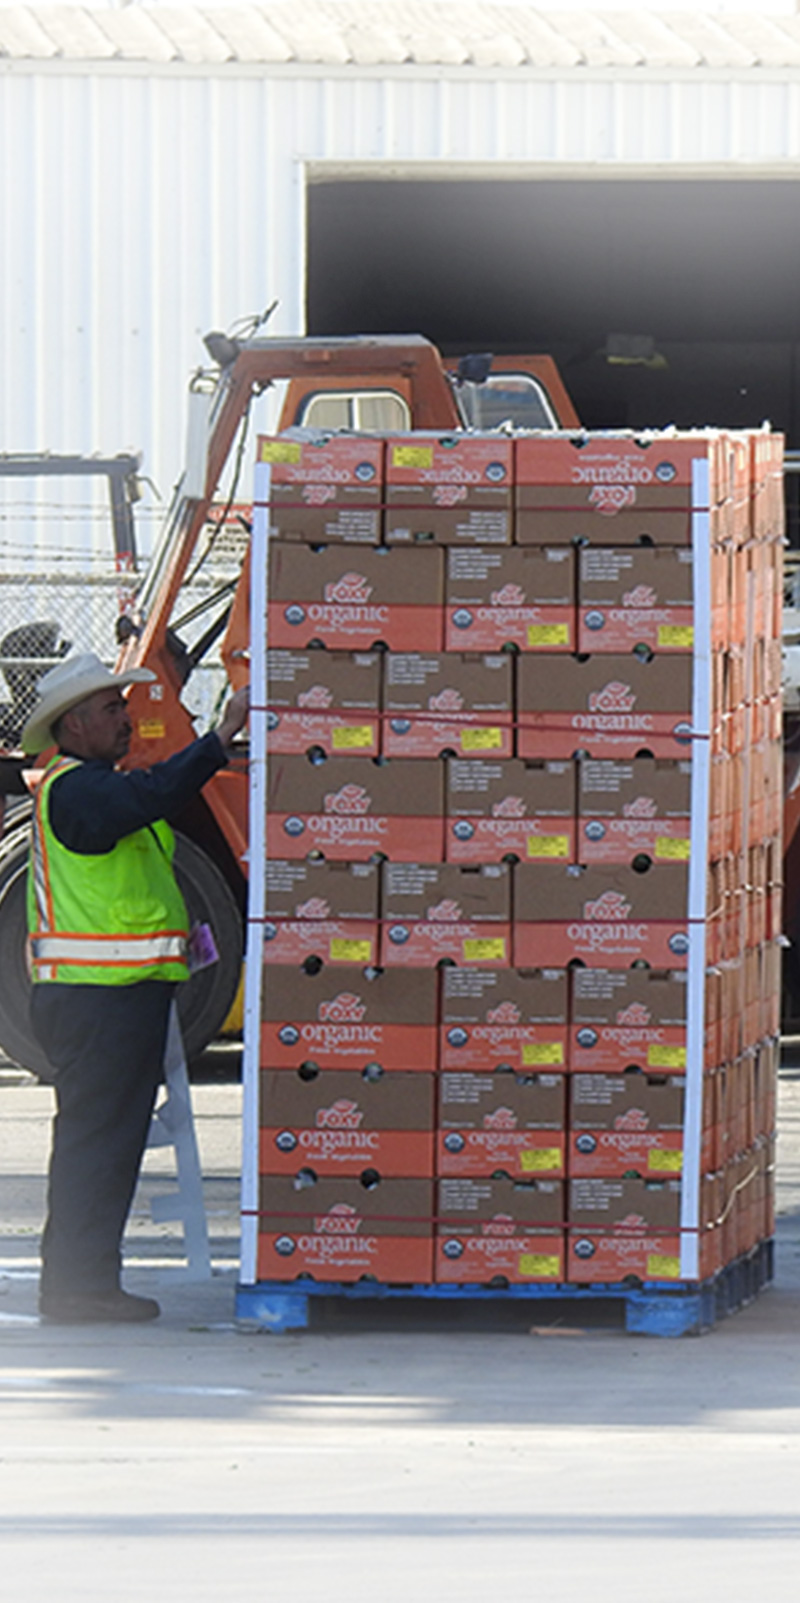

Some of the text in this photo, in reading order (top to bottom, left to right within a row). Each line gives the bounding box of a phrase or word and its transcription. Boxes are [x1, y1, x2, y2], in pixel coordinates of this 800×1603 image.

[571, 463, 653, 483] organic
[307, 603, 389, 626] organic
[476, 607, 542, 625] organic
[608, 608, 673, 626] organic
[571, 713, 653, 737] organic
[306, 815, 388, 838] organic
[477, 819, 541, 836] organic
[609, 820, 673, 837] organic
[566, 923, 649, 945] organic
[301, 1024, 383, 1048] organic
[472, 1026, 536, 1044] organic
[601, 1026, 666, 1045] organic
[298, 1130, 380, 1154] organic
[468, 1131, 533, 1150] organic
[599, 1132, 664, 1152] organic
[314, 1216, 361, 1233] FOXY
[297, 1235, 378, 1259] organic
[466, 1237, 530, 1256] organic
[598, 1238, 663, 1257] organic
